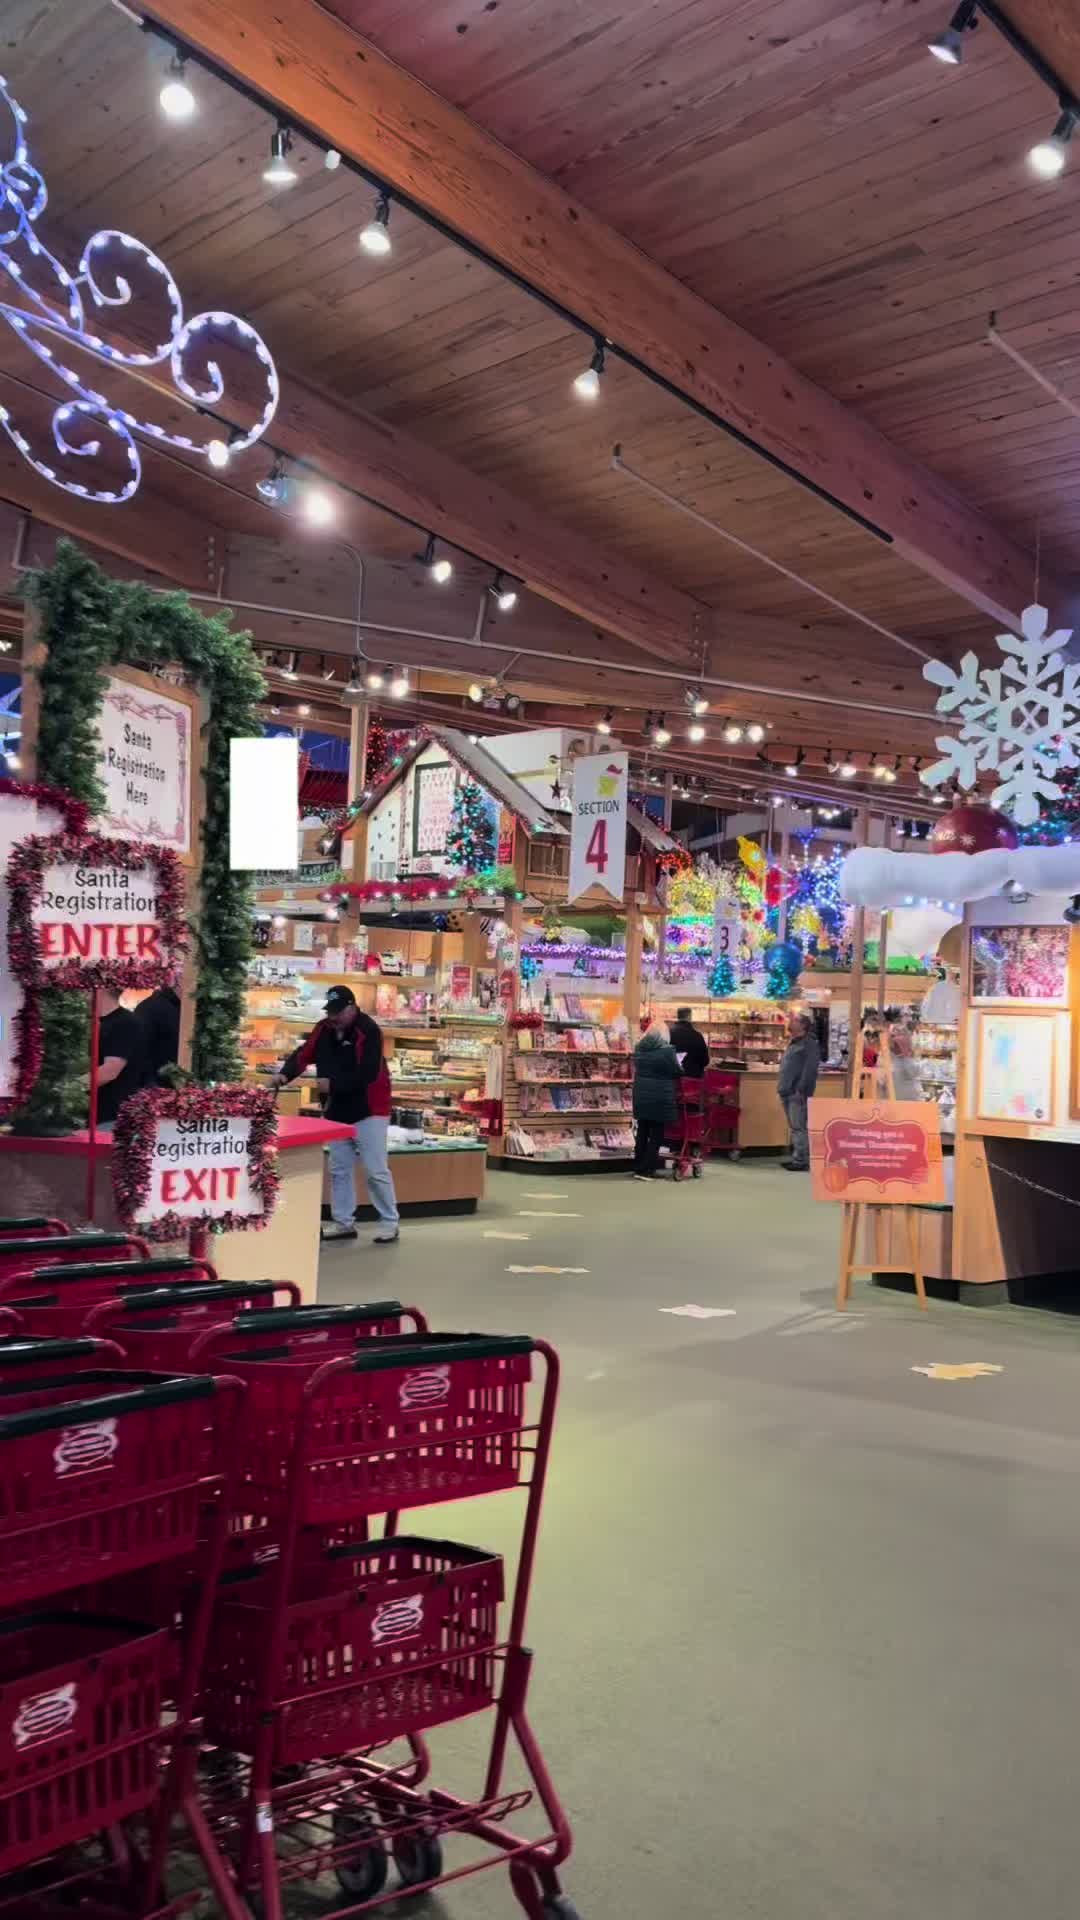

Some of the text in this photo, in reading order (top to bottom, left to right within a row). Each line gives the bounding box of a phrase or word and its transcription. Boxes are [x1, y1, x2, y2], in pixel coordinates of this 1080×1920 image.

[124, 723, 152, 751] Santa
[109, 747, 165, 782] Registration
[127, 781, 148, 805] Here
[578, 800, 620, 815] SECTION
[585, 819, 608, 874] 4
[75, 868, 129, 888] Santa
[42, 890, 158, 916] Registration
[41, 922, 161, 957] ENTER
[719, 926, 729, 950] 3
[161, 1167, 240, 1203] EXIT
